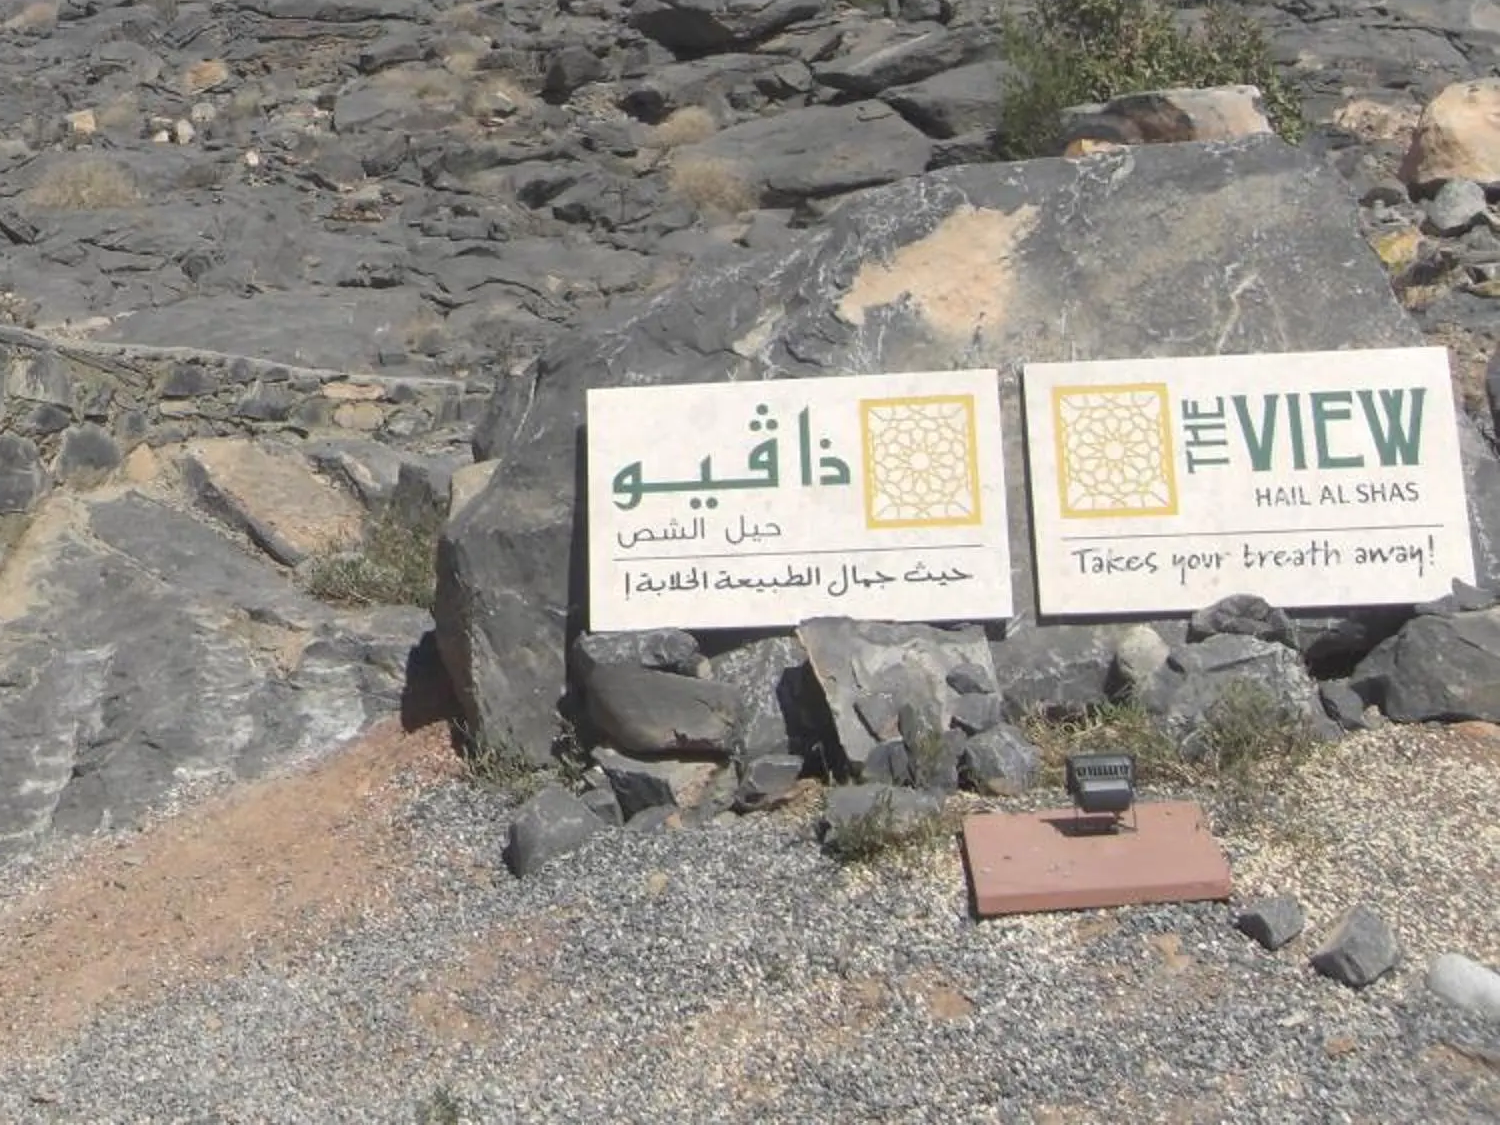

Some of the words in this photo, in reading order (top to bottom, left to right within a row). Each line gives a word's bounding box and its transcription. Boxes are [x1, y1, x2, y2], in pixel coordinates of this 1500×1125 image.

[1181, 396, 1229, 474] THE
[1232, 387, 1426, 471] VIEW
[799, 405, 850, 486] ذا
[1255, 486, 1312, 507] HAIL
[1319, 483, 1352, 505] AL
[1358, 482, 1419, 503] SHAS
[617, 517, 705, 549] الشص
[725, 514, 781, 544] حيل
[904, 561, 972, 582] حيث
[1072, 548, 1159, 574] Takes
[1172, 550, 1228, 584] your
[1243, 543, 1341, 568] breath
[1354, 536, 1435, 576] away!
[718, 566, 820, 593] الطبيعة
[827, 565, 897, 597] جمال
